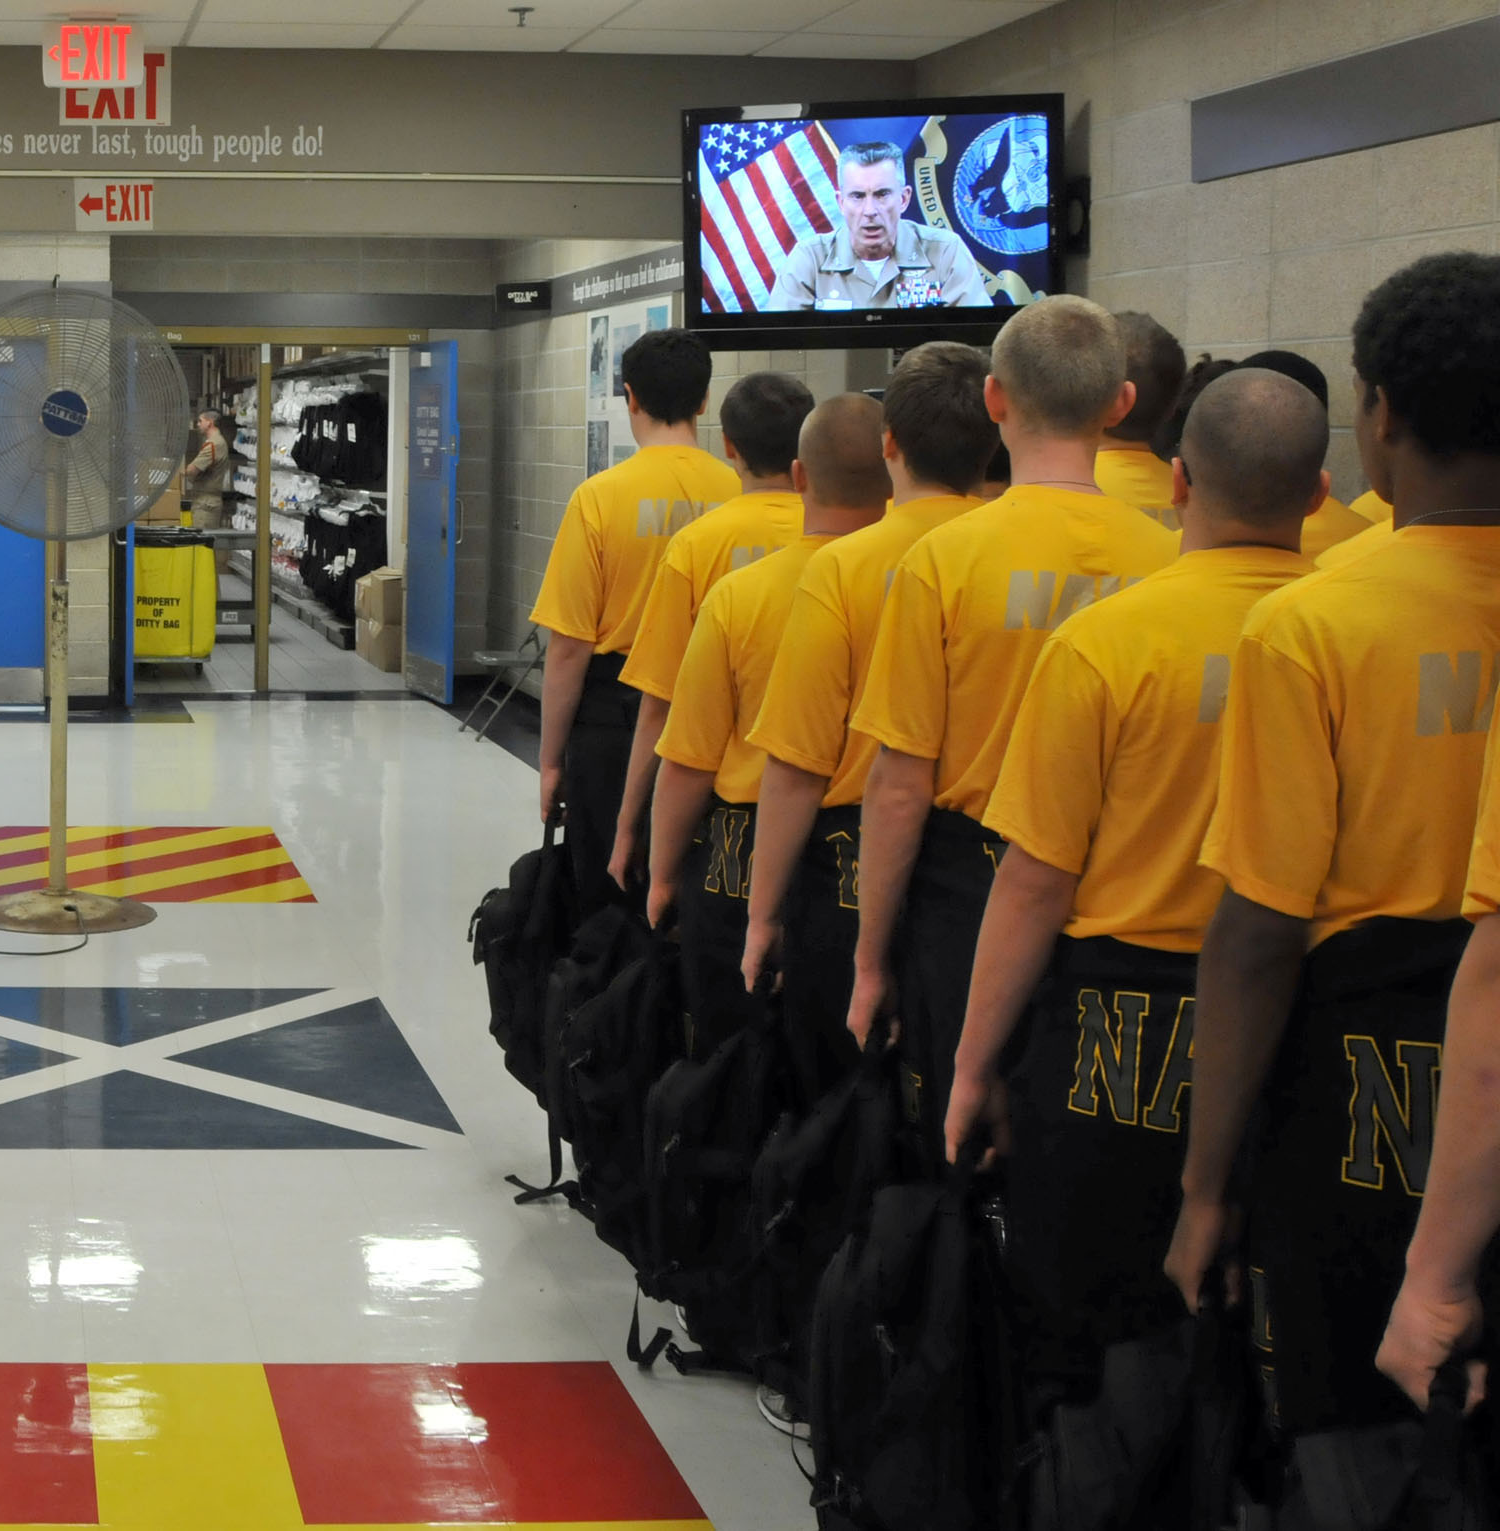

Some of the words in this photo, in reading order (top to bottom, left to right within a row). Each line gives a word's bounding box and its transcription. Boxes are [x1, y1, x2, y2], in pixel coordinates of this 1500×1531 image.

[61, 26, 132, 81] EXIT
[24, 134, 81, 154] never
[92, 125, 136, 158] last,
[144, 124, 203, 162] tough
[213, 125, 282, 163] people
[292, 125, 324, 156] do!
[106, 184, 154, 222] EXIT
[919, 167, 937, 212] UNITED
[137, 596, 180, 606] PROPERTY
[153, 608, 164, 617] OF
[136, 619, 160, 628] DITTY
[163, 620, 180, 628] BAG
[1068, 988, 1197, 1133] NA
